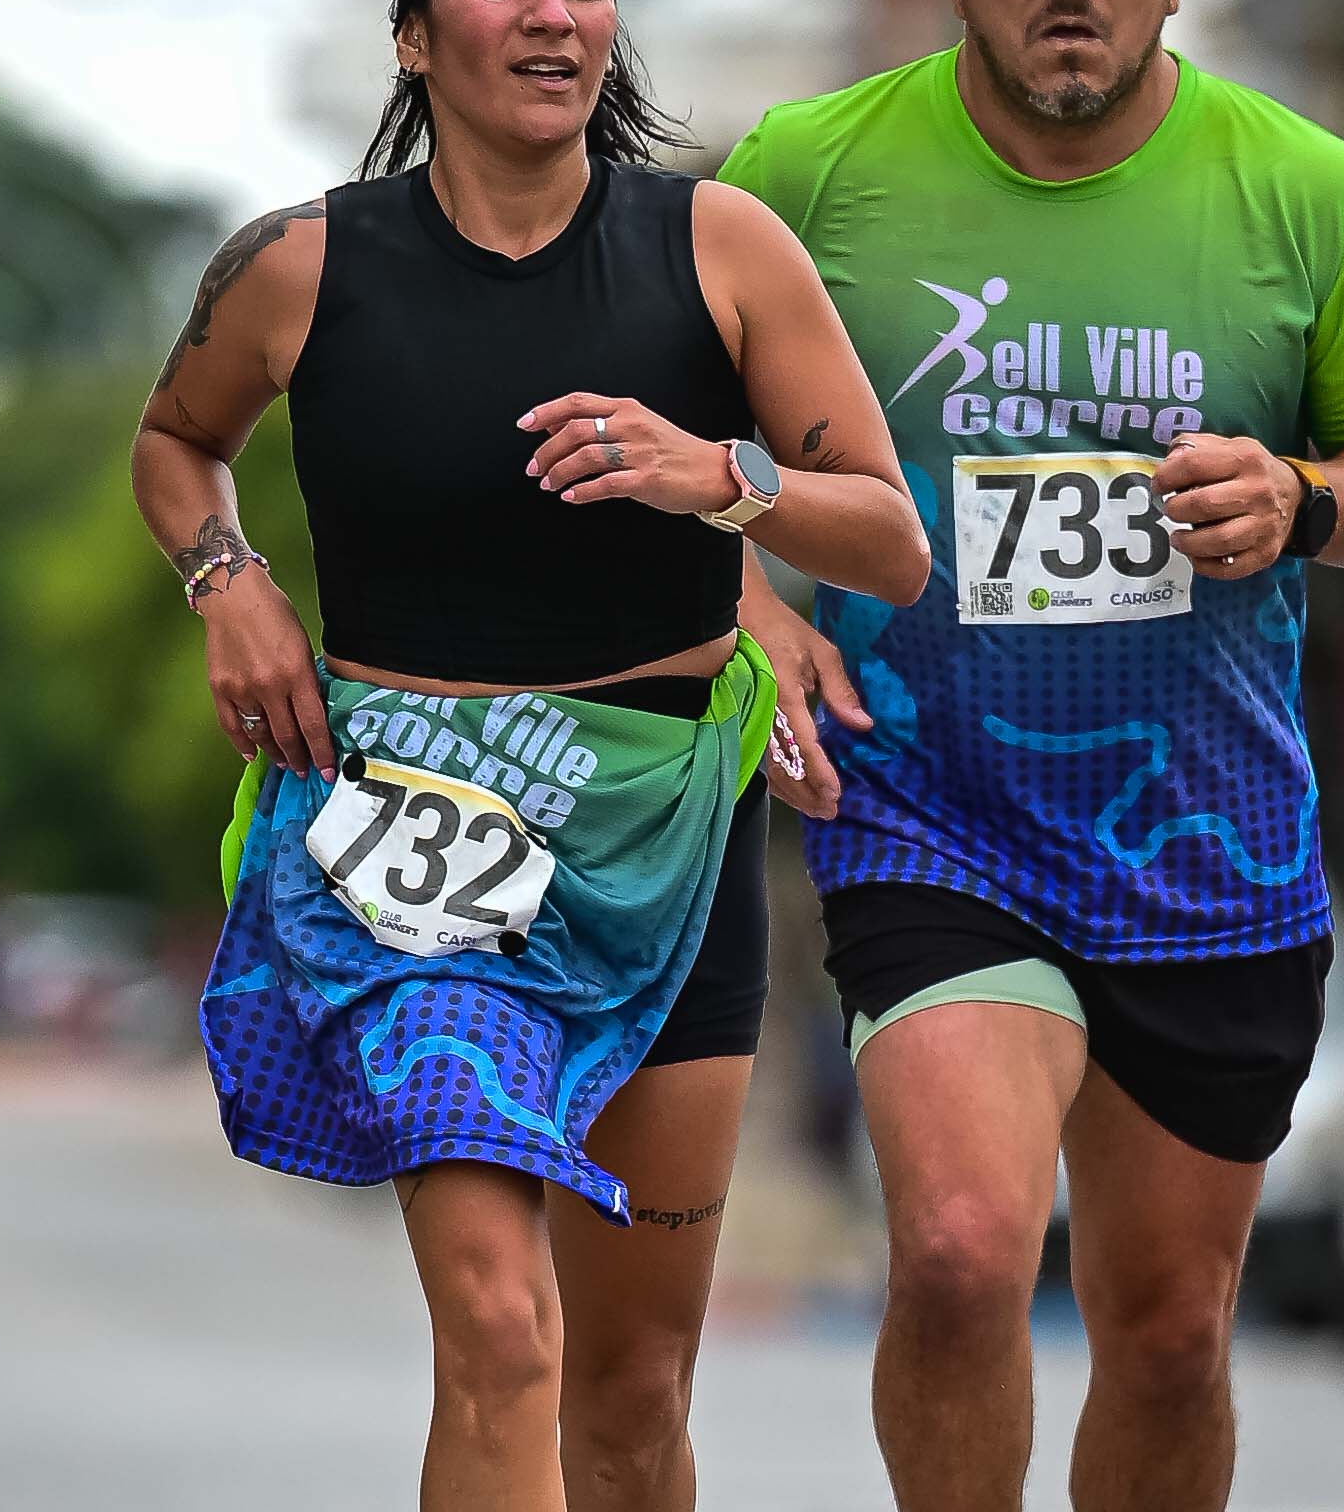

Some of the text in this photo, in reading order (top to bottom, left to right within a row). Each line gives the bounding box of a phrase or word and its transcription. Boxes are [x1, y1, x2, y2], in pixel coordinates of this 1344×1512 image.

[1085, 326, 1203, 401] Ville
[942, 393, 1203, 444] corre
[975, 471, 1171, 580] 733
[1109, 588, 1174, 606] CARUSO
[347, 710, 576, 828] corre
[482, 692, 598, 787] Ville
[330, 777, 531, 927] 732
